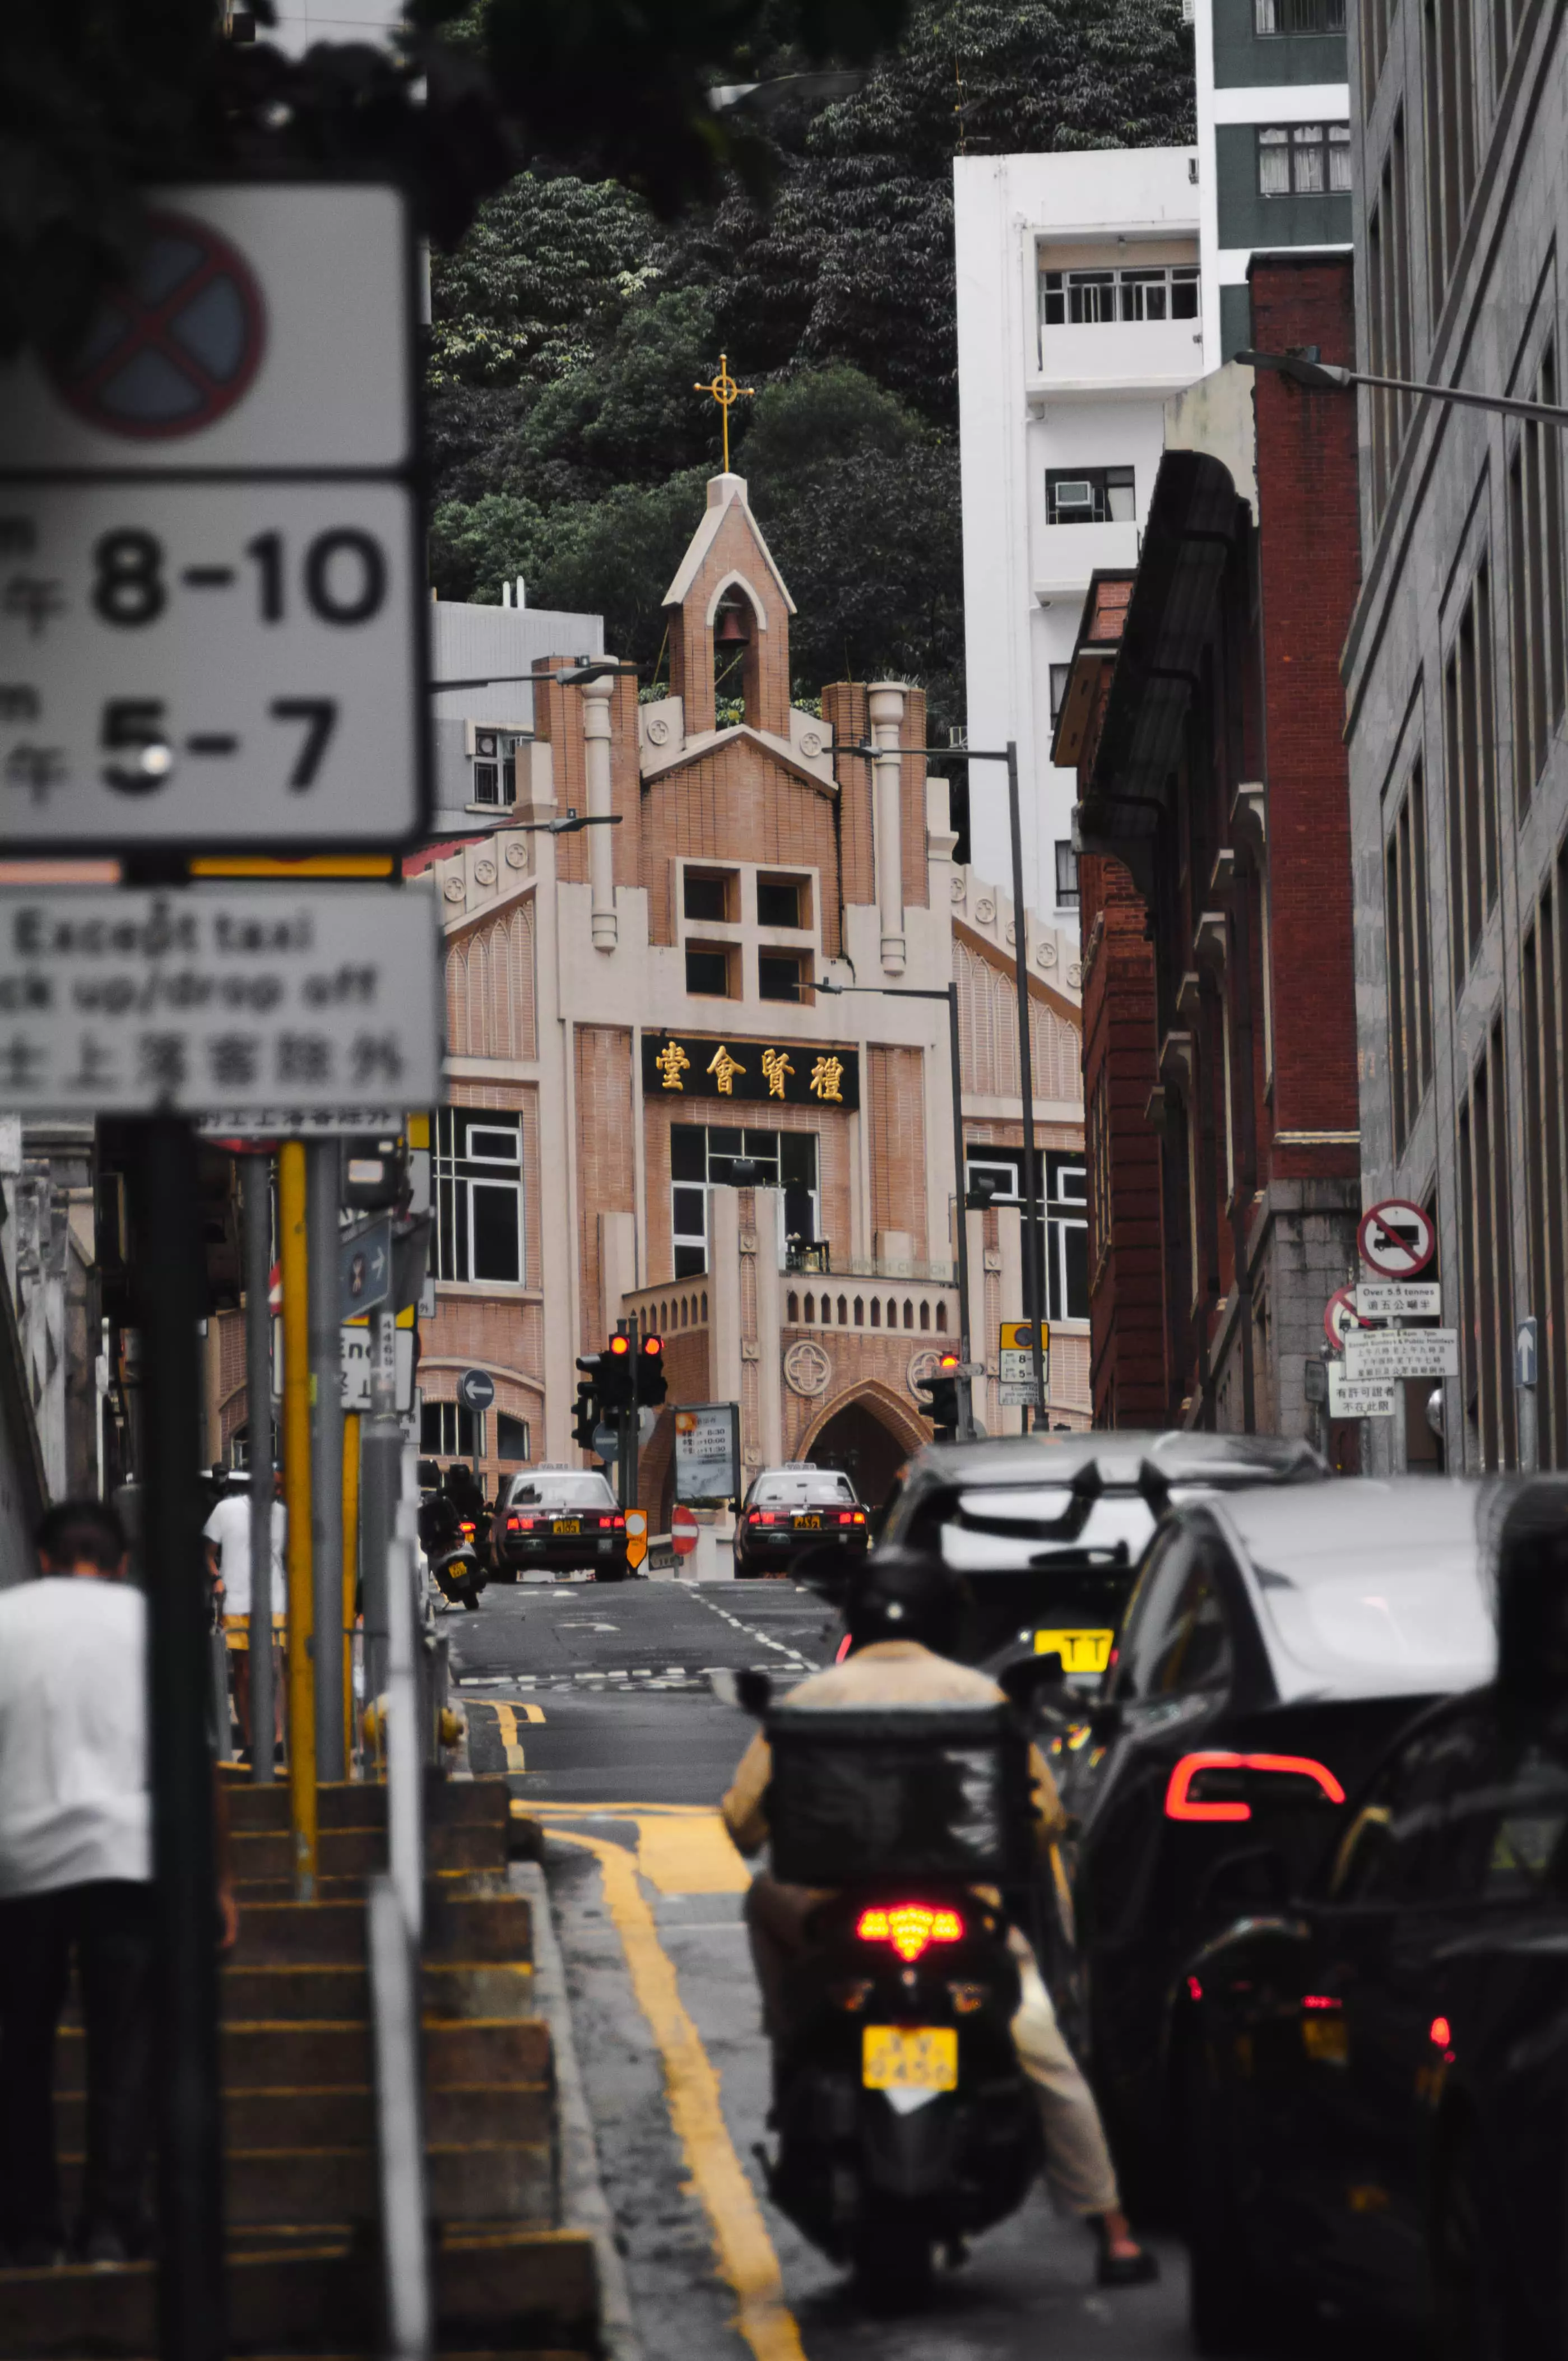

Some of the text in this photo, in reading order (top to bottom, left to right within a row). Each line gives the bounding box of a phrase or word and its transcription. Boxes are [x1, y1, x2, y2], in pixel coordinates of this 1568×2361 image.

[92, 527, 388, 628] 8-10
[101, 698, 339, 796] 5-7
[1388, 1288, 1402, 1296] 5.5
